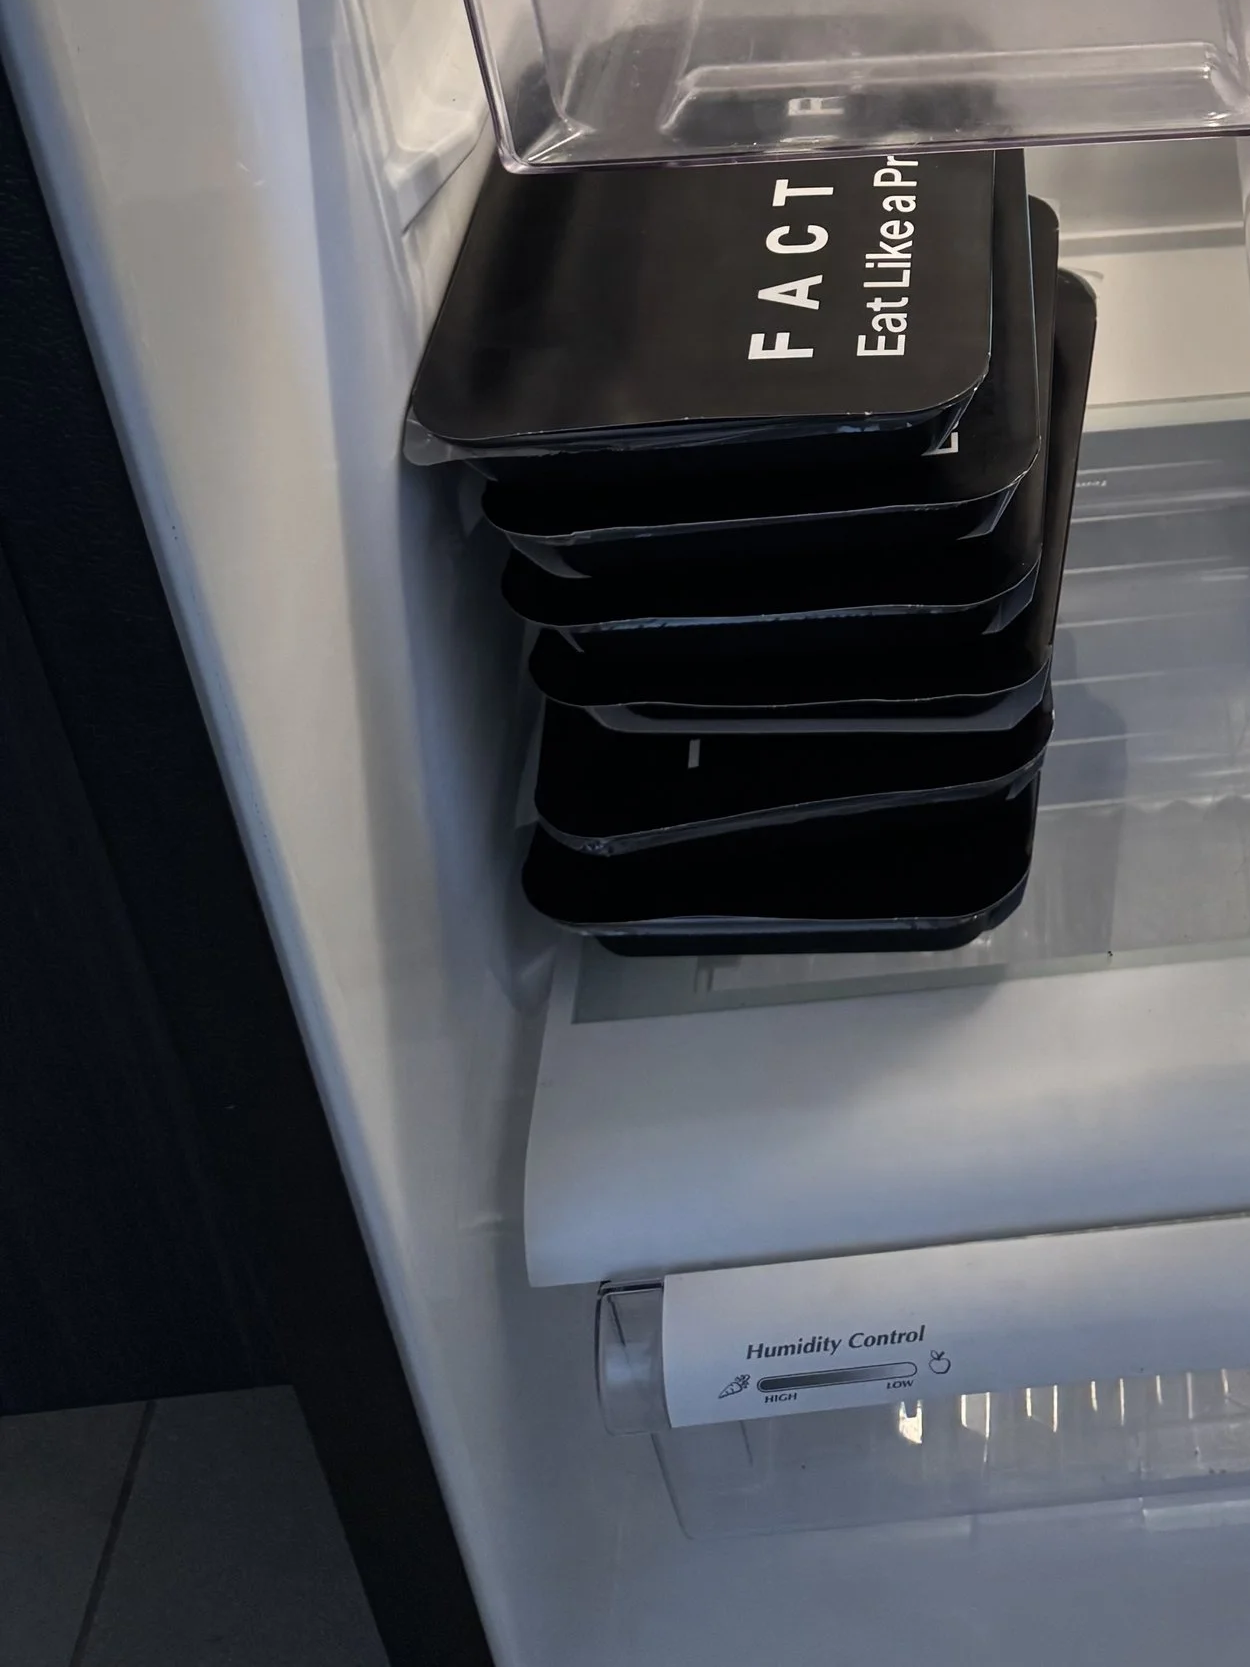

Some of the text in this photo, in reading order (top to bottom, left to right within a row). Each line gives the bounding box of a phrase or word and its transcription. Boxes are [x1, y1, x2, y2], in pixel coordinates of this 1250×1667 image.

[881, 194, 917, 213] a
[862, 219, 916, 288] Like
[856, 297, 910, 357] Eat
[746, 1324, 926, 1360] Humidity Control
[764, 1379, 915, 1404] HIGH LOW
